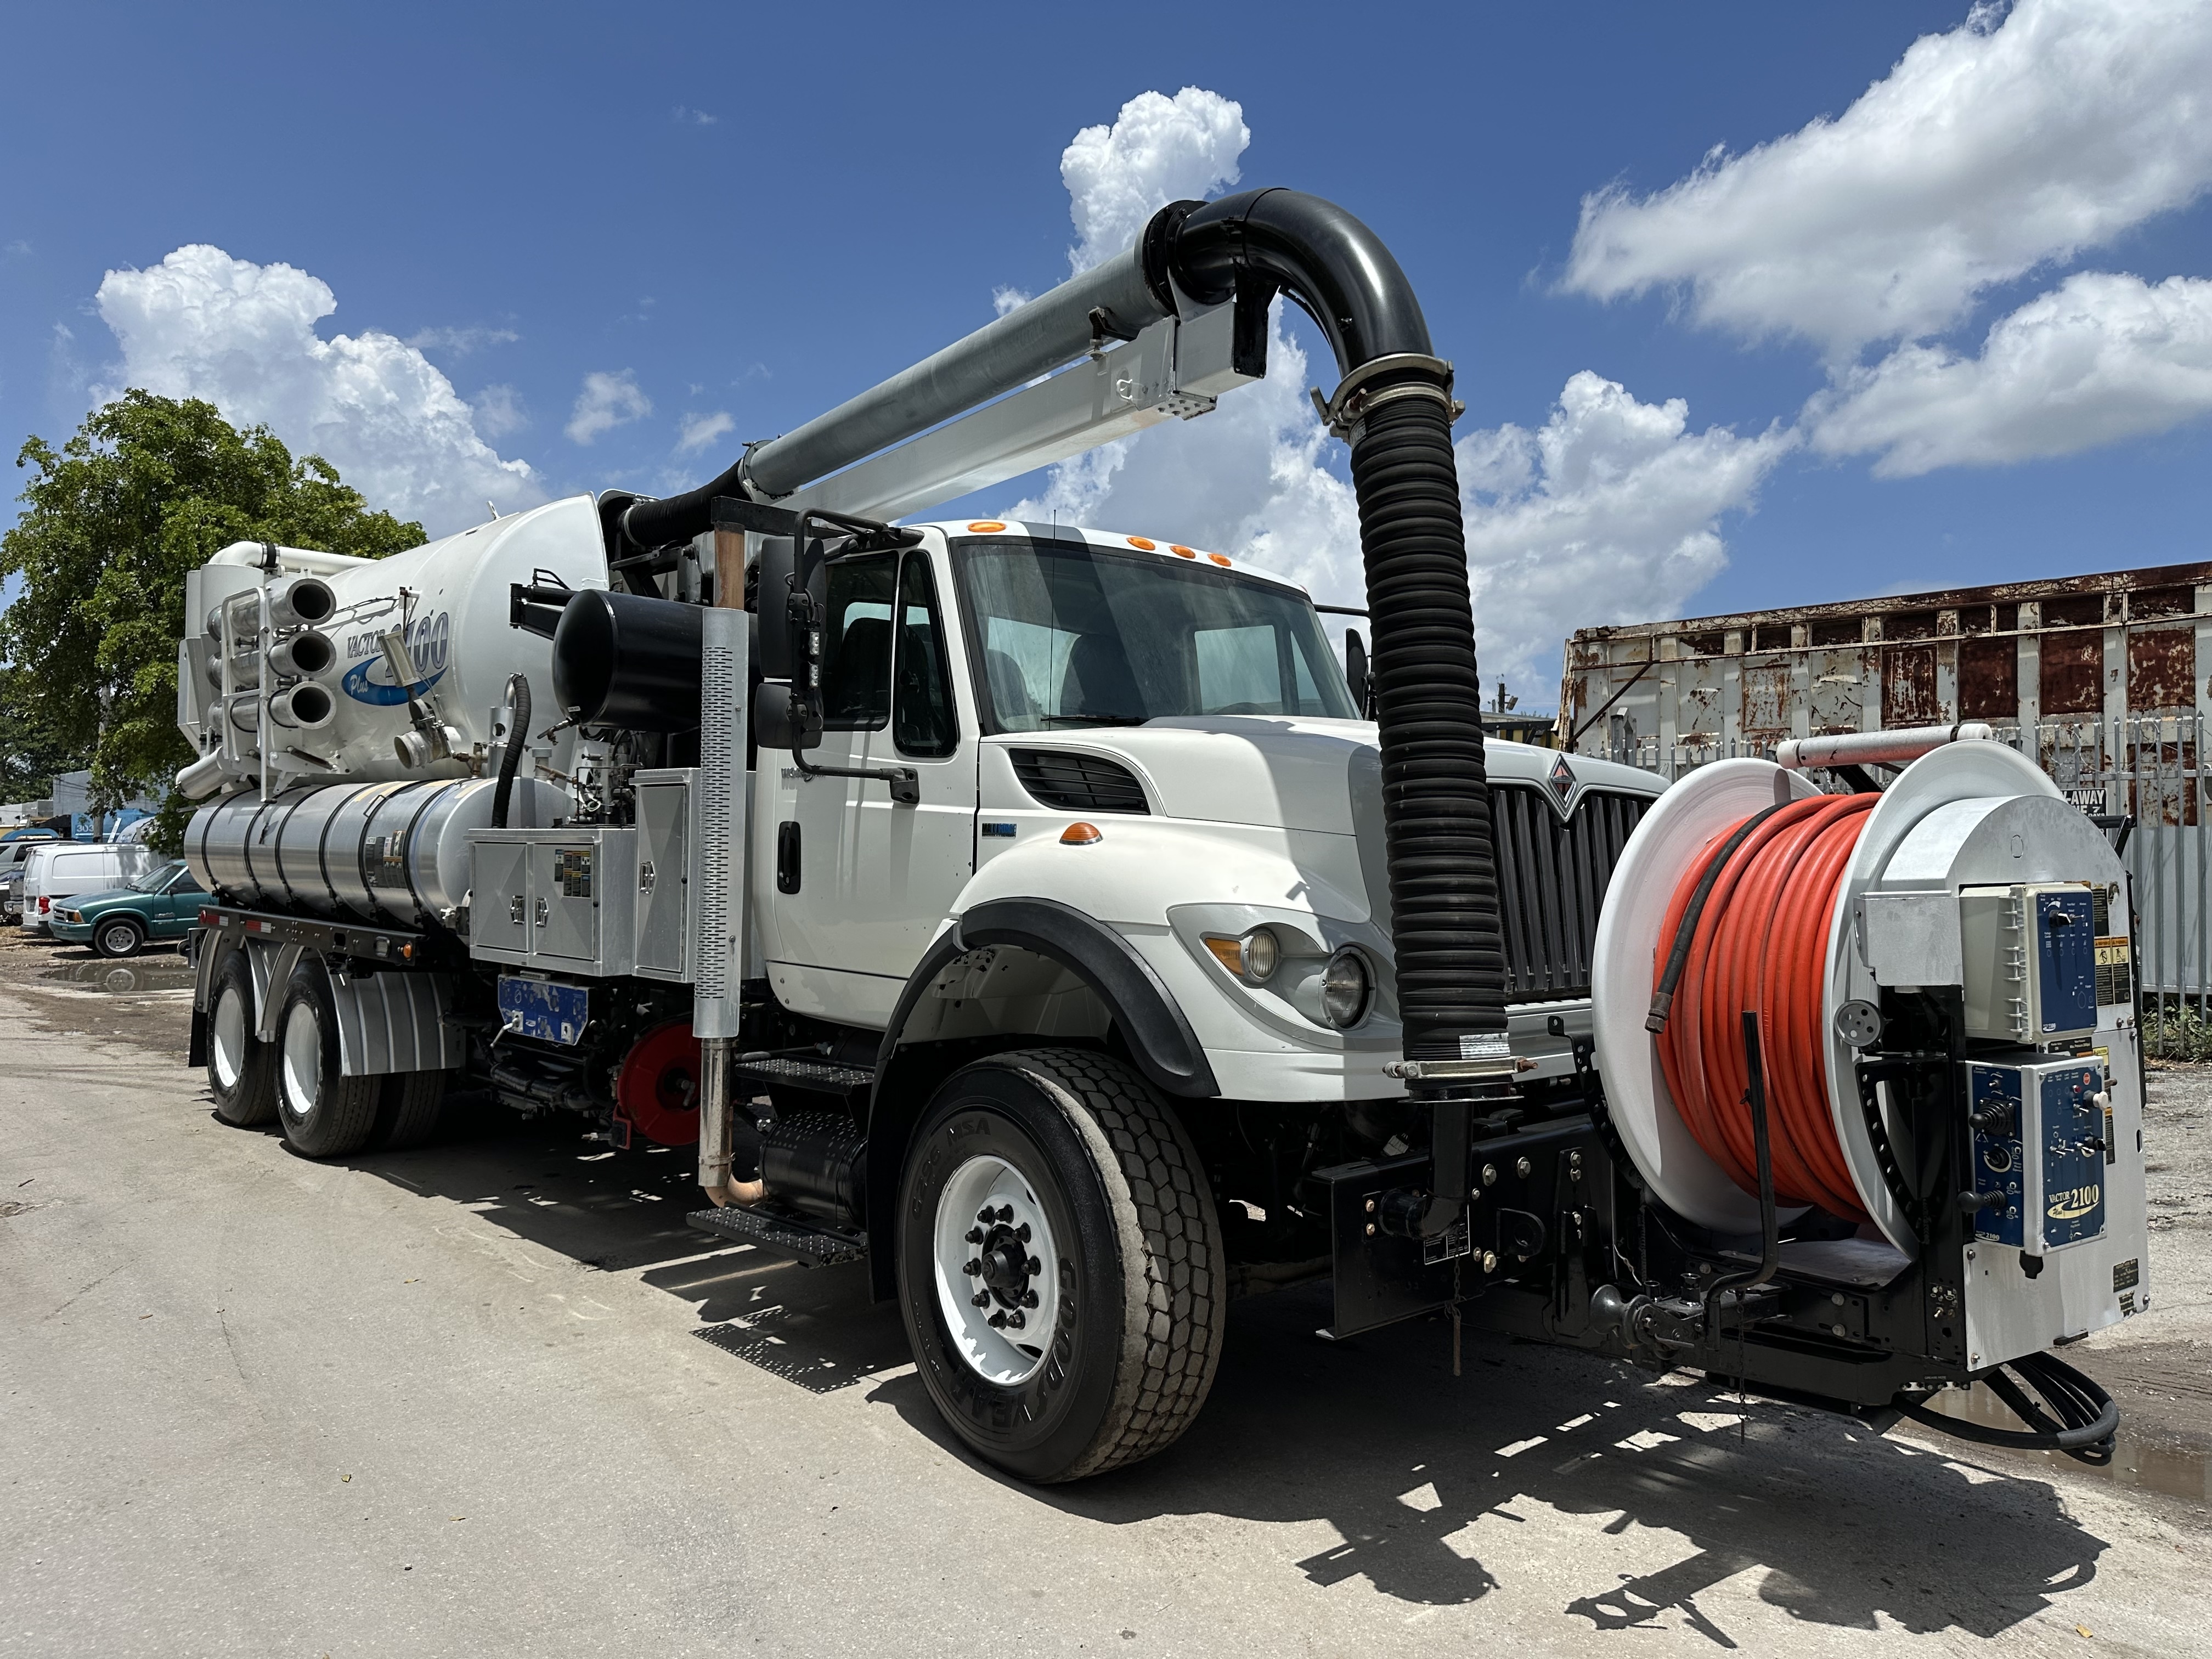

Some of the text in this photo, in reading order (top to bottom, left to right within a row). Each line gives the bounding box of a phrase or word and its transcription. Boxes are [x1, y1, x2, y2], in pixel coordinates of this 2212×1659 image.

[350, 674, 369, 695] Plus
[2049, 1184, 2099, 1208] VACTOR 2100
